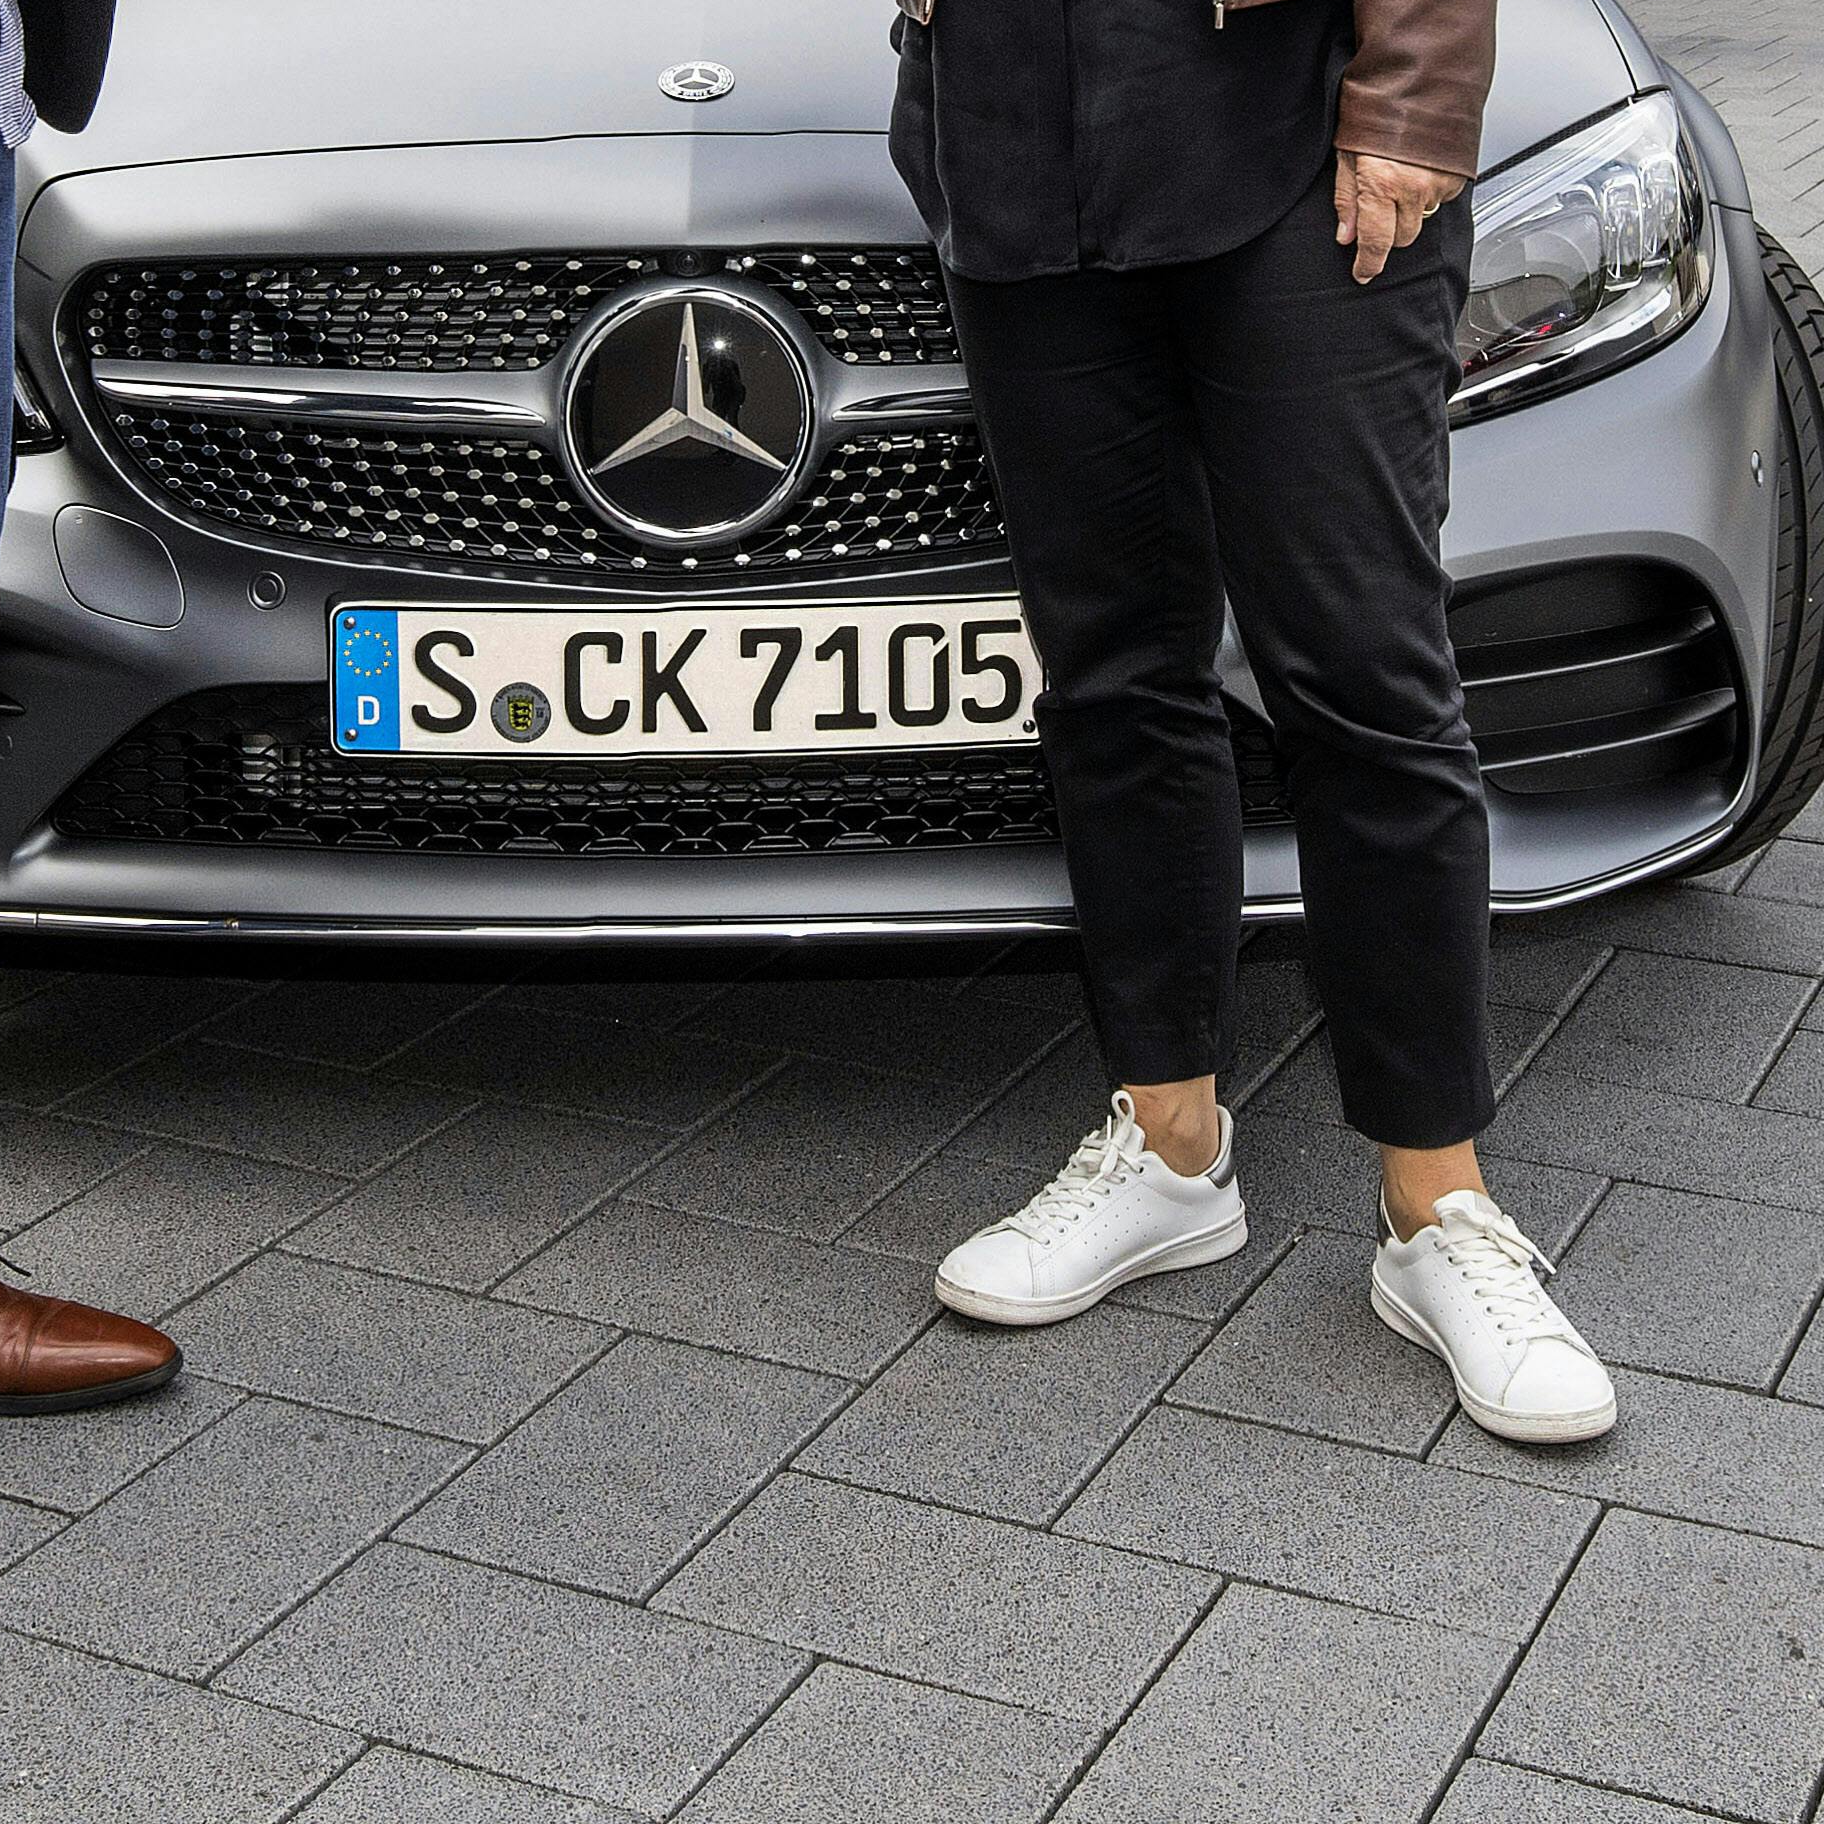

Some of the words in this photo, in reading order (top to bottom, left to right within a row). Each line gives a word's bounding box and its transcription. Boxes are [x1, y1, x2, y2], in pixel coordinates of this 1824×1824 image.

[357, 695, 381, 726] D
[411, 630, 478, 734] S
[564, 628, 709, 736] CK
[739, 618, 1024, 732] 7105
